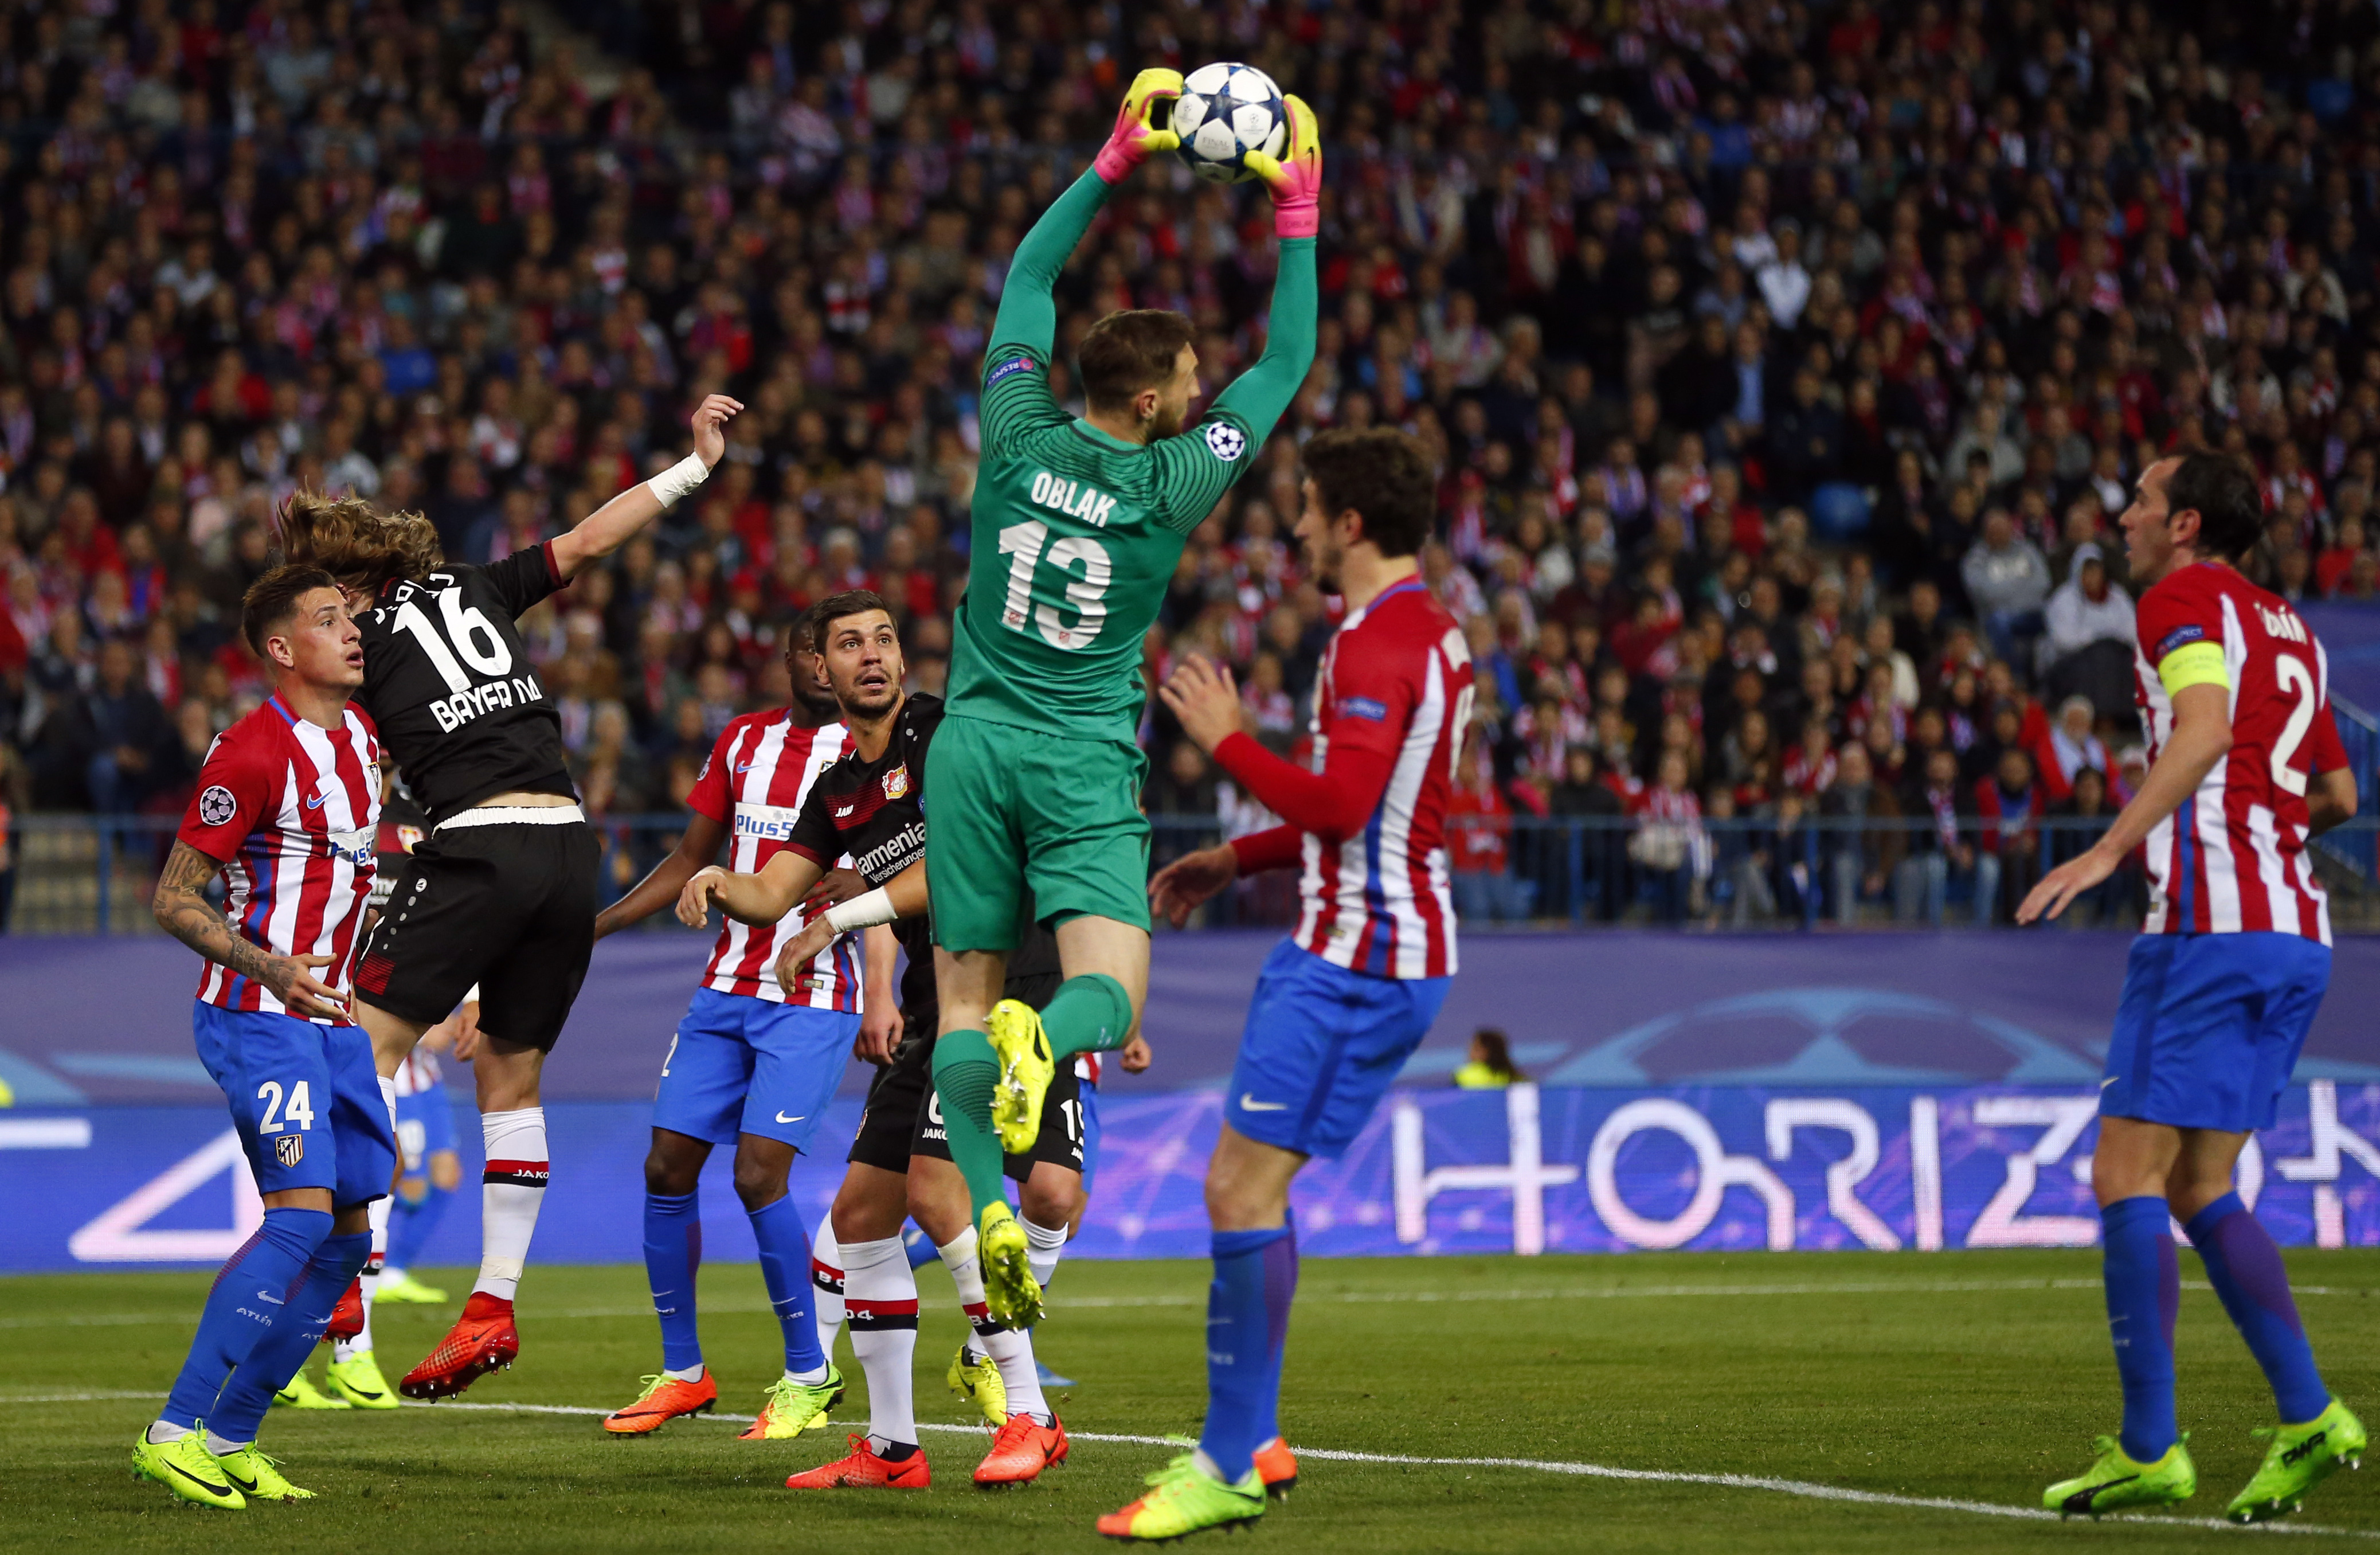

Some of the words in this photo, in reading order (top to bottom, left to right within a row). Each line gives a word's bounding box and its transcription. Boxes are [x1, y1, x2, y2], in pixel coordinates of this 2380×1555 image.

[1031, 472, 1117, 528] OBLAK
[998, 519, 1112, 651] 13
[391, 585, 513, 695] 16
[2270, 653, 2316, 798] 2
[256, 1080, 315, 1135] 24
[512, 1169, 549, 1179] JAKO
